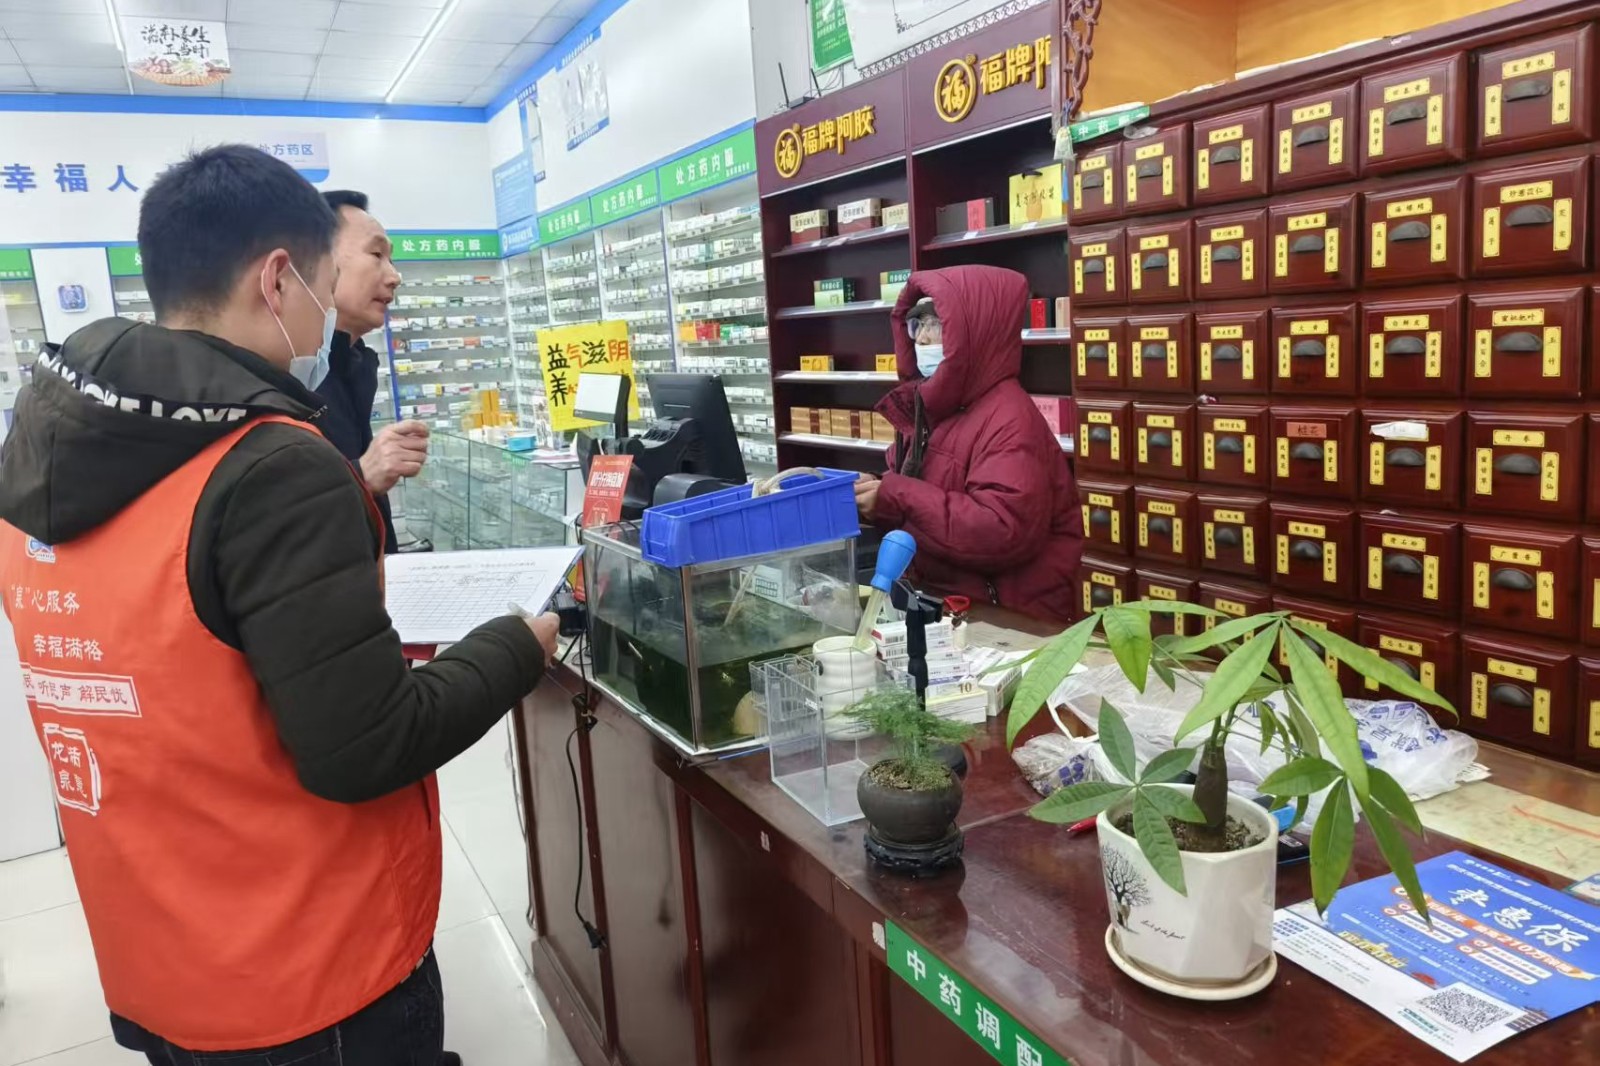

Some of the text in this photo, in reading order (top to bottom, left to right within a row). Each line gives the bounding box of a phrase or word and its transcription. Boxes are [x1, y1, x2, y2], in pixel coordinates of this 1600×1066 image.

[801, 105, 876, 155] 福牌阿胶
[1078, 112, 1147, 137] 中药
[260, 143, 314, 156] 处方药区
[675, 147, 735, 186] 处方药内服
[402, 238, 481, 252] 处方药内服
[548, 339, 629, 371] 益气滋阴
[1297, 424, 1319, 437] 桂花
[1499, 550, 1532, 561] 广藿香
[33, 634, 104, 661] 幸福满格
[77, 685, 127, 705] 解民忧
[958, 682, 972, 694] 10
[906, 949, 1043, 1066] 中药调配
